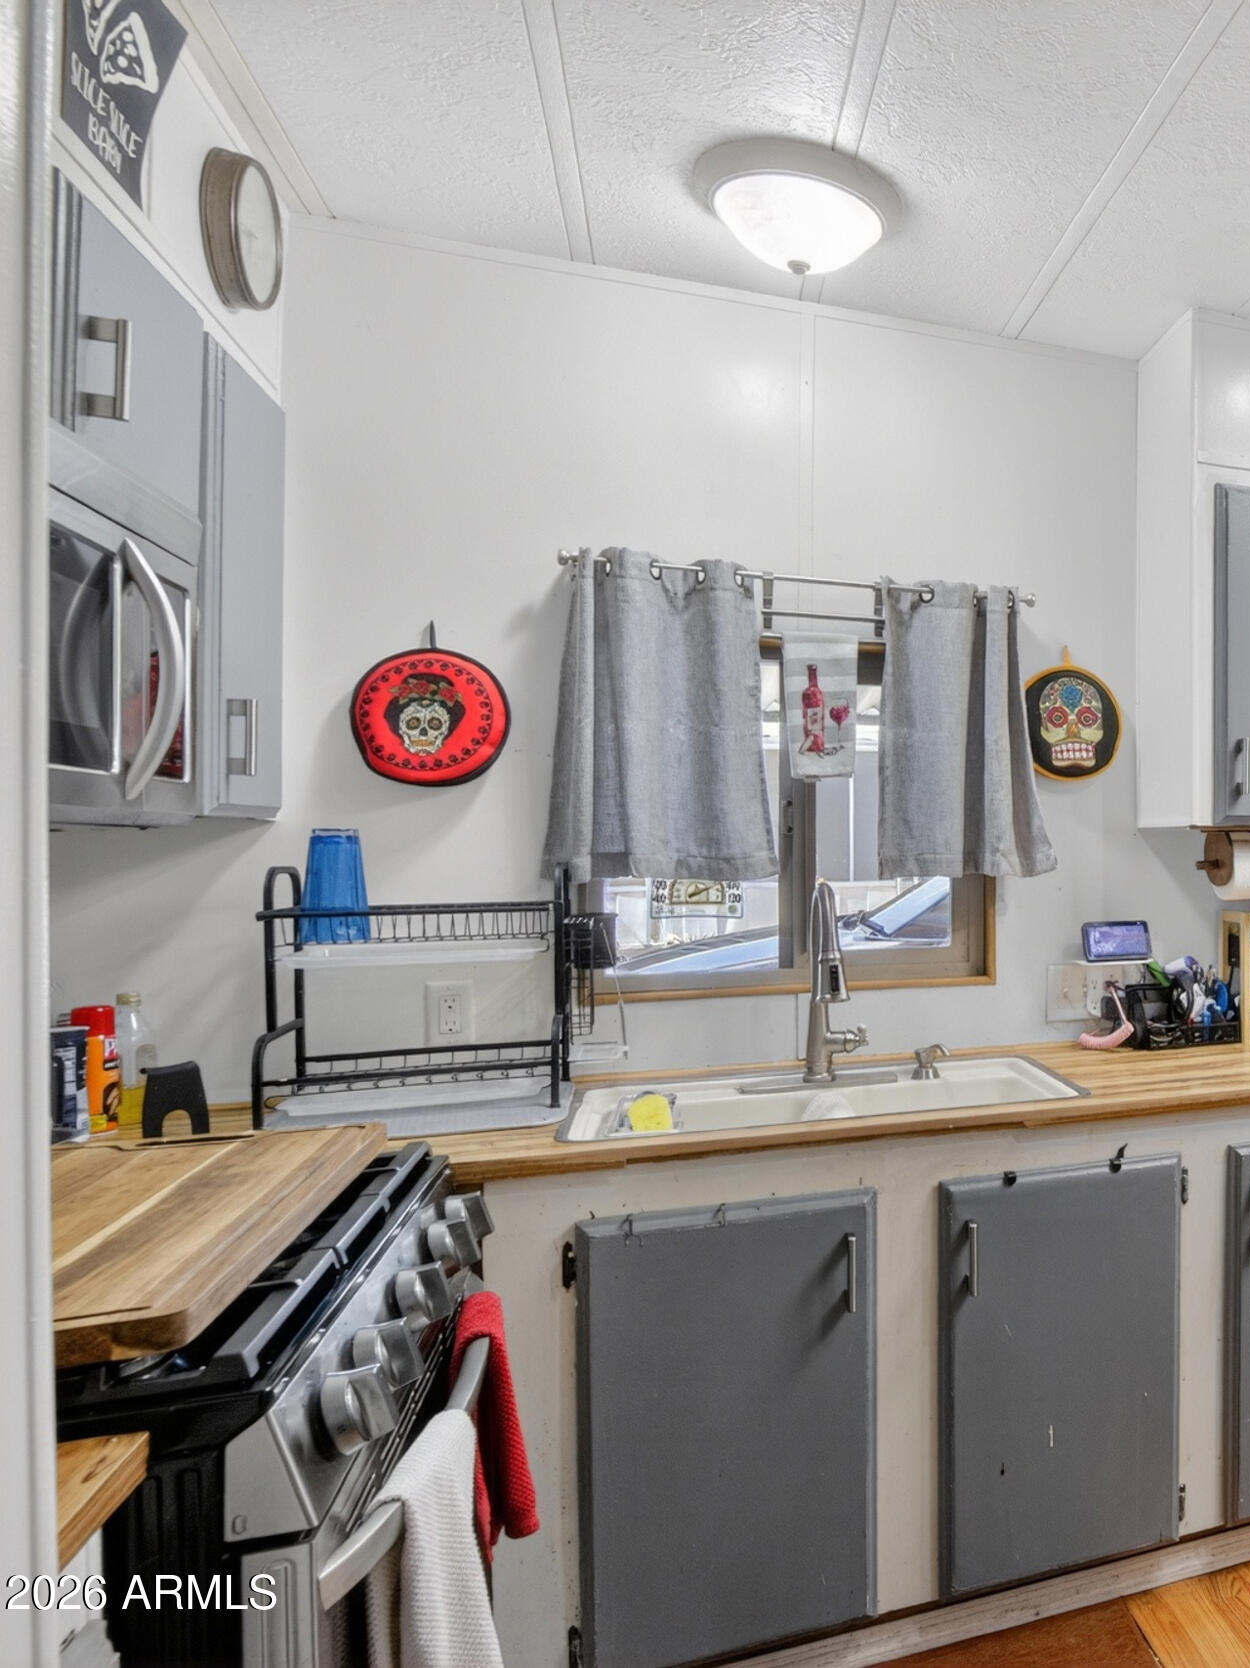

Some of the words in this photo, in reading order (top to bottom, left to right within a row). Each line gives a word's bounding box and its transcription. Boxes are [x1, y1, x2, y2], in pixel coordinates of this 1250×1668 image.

[70, 52, 111, 115] SLICE
[109, 101, 144, 159] SLICE
[87, 112, 121, 174] BABY
